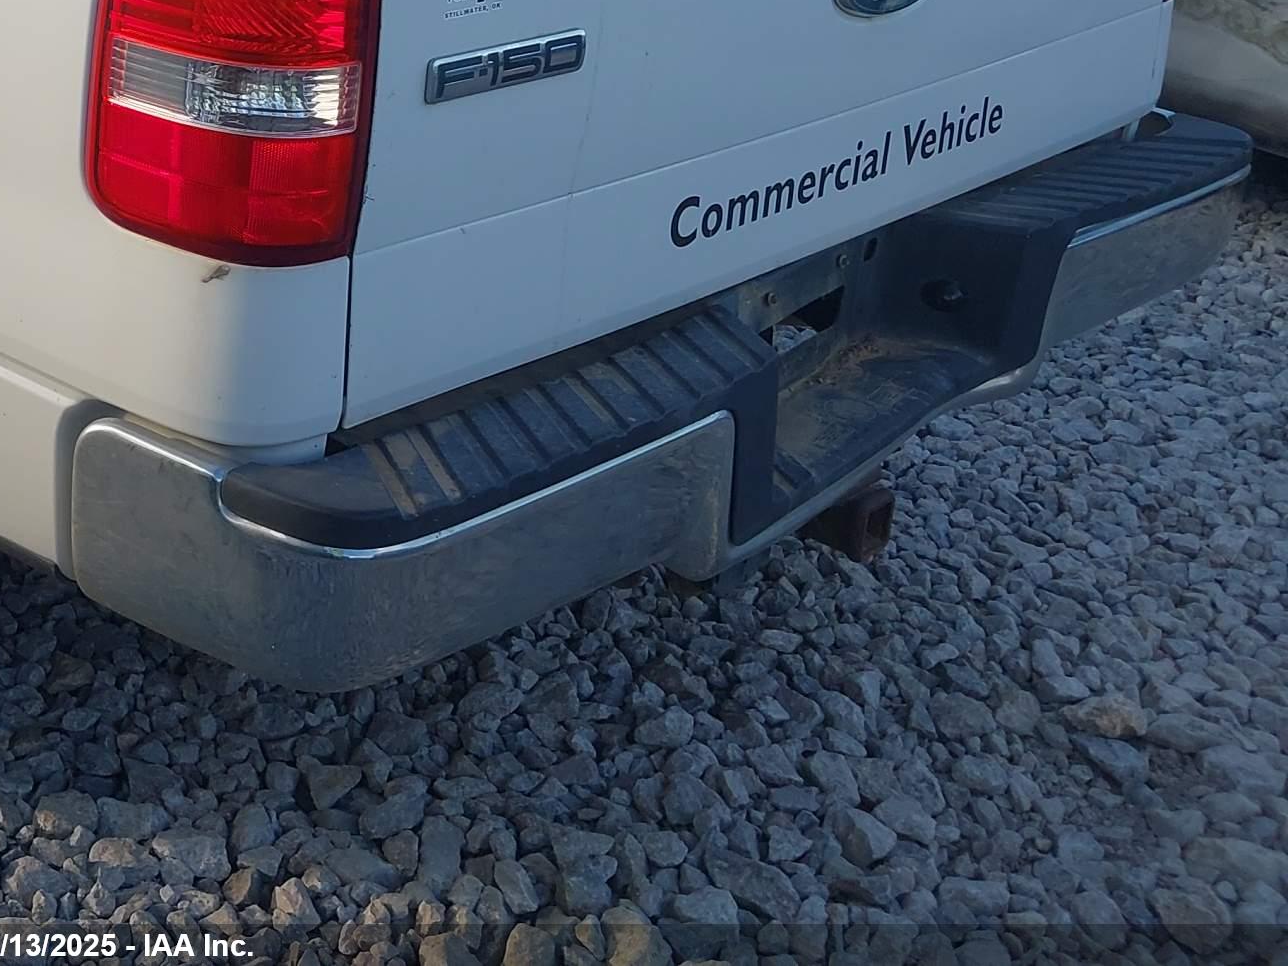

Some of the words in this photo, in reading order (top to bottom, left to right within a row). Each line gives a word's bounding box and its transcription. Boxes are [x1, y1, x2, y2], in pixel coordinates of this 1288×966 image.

[434, 34, 584, 100] F-150
[670, 131, 892, 248] Commercial
[903, 96, 1004, 166] Vehicle
